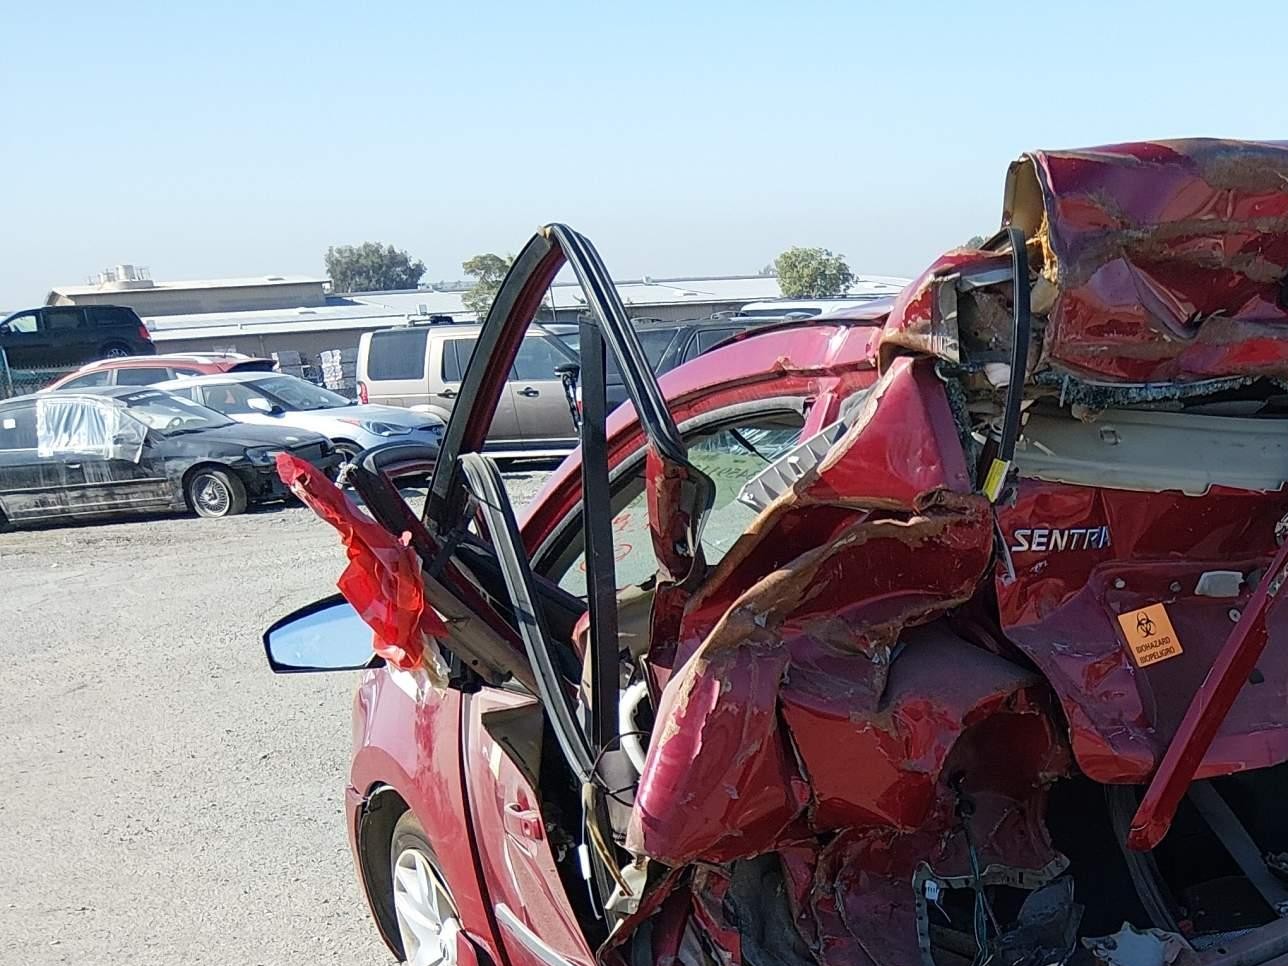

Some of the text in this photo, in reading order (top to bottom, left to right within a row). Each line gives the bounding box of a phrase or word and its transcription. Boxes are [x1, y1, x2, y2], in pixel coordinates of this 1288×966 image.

[1011, 526, 1111, 552] SENTRA
[1135, 636, 1171, 654] BIOHAZARD
[1139, 646, 1176, 664] BIOPELIGRO
